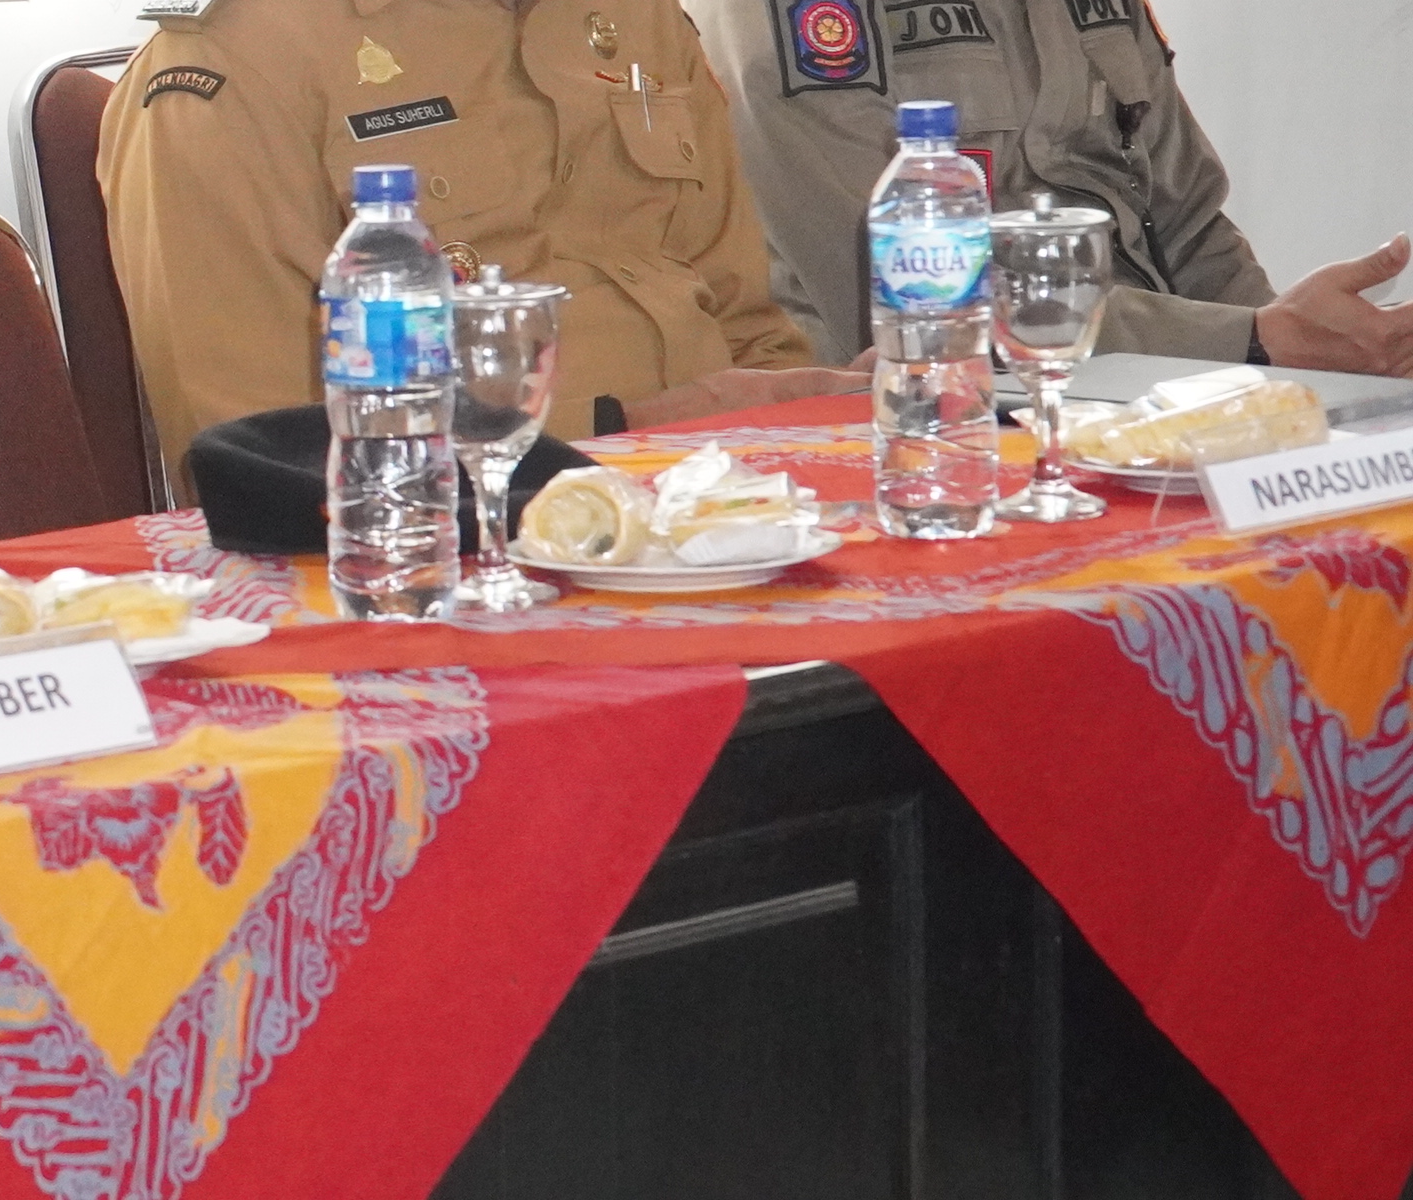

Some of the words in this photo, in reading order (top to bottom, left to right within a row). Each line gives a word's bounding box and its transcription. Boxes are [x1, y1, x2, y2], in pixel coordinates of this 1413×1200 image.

[365, 114, 395, 131] AGUS
[395, 104, 444, 124] SUHERLI
[891, 245, 967, 278] AQUA
[1250, 449, 1413, 511] NARASUMB
